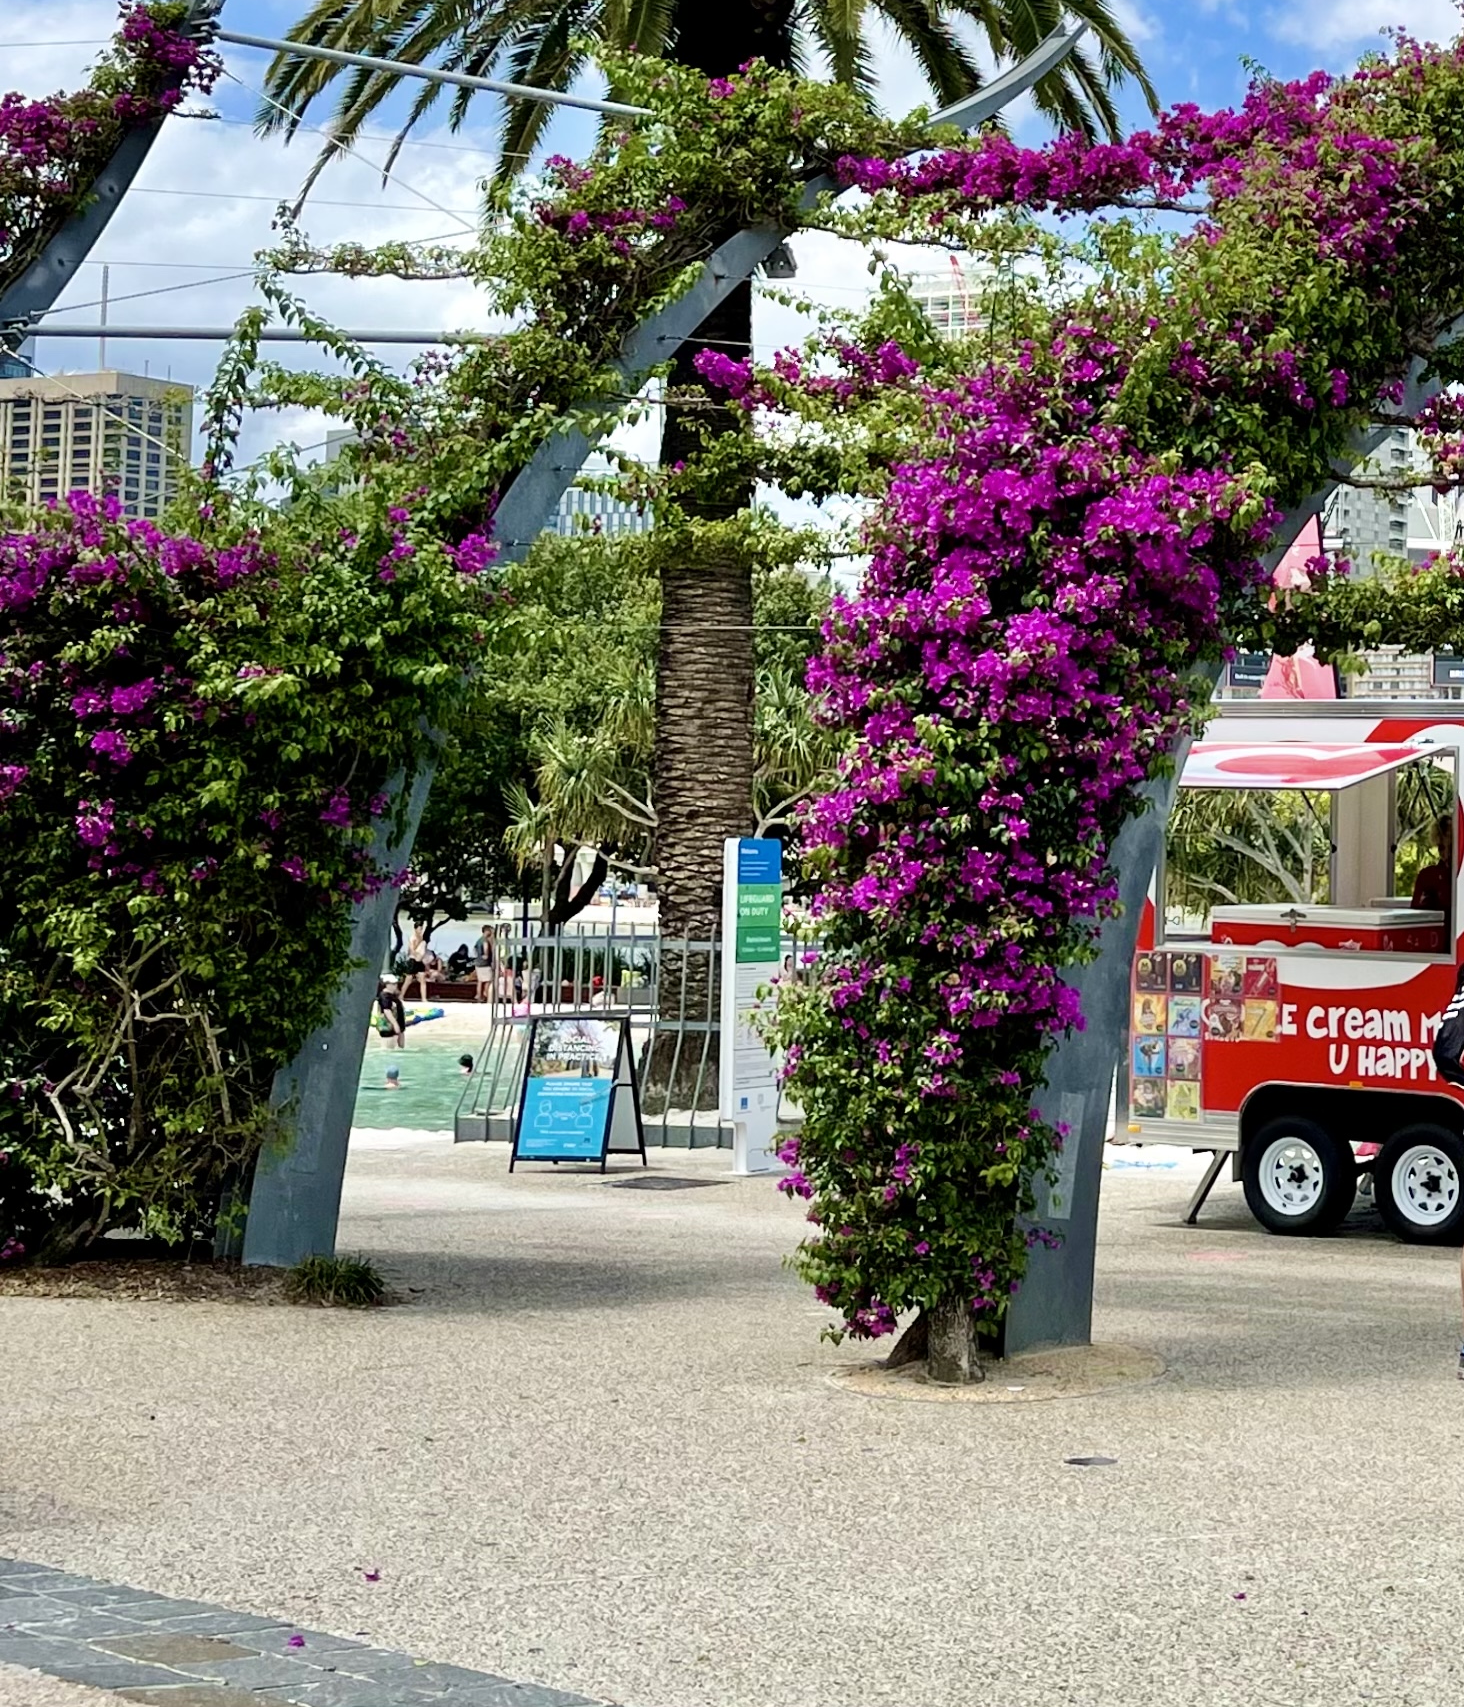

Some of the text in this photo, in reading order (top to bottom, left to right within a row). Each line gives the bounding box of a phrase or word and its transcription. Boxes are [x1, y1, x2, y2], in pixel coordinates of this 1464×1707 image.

[739, 907, 769, 916] ON DUTY
[548, 1044, 601, 1052] DISTANCING
[546, 1052, 556, 1061] IN
[1328, 1043, 1349, 1075] U
